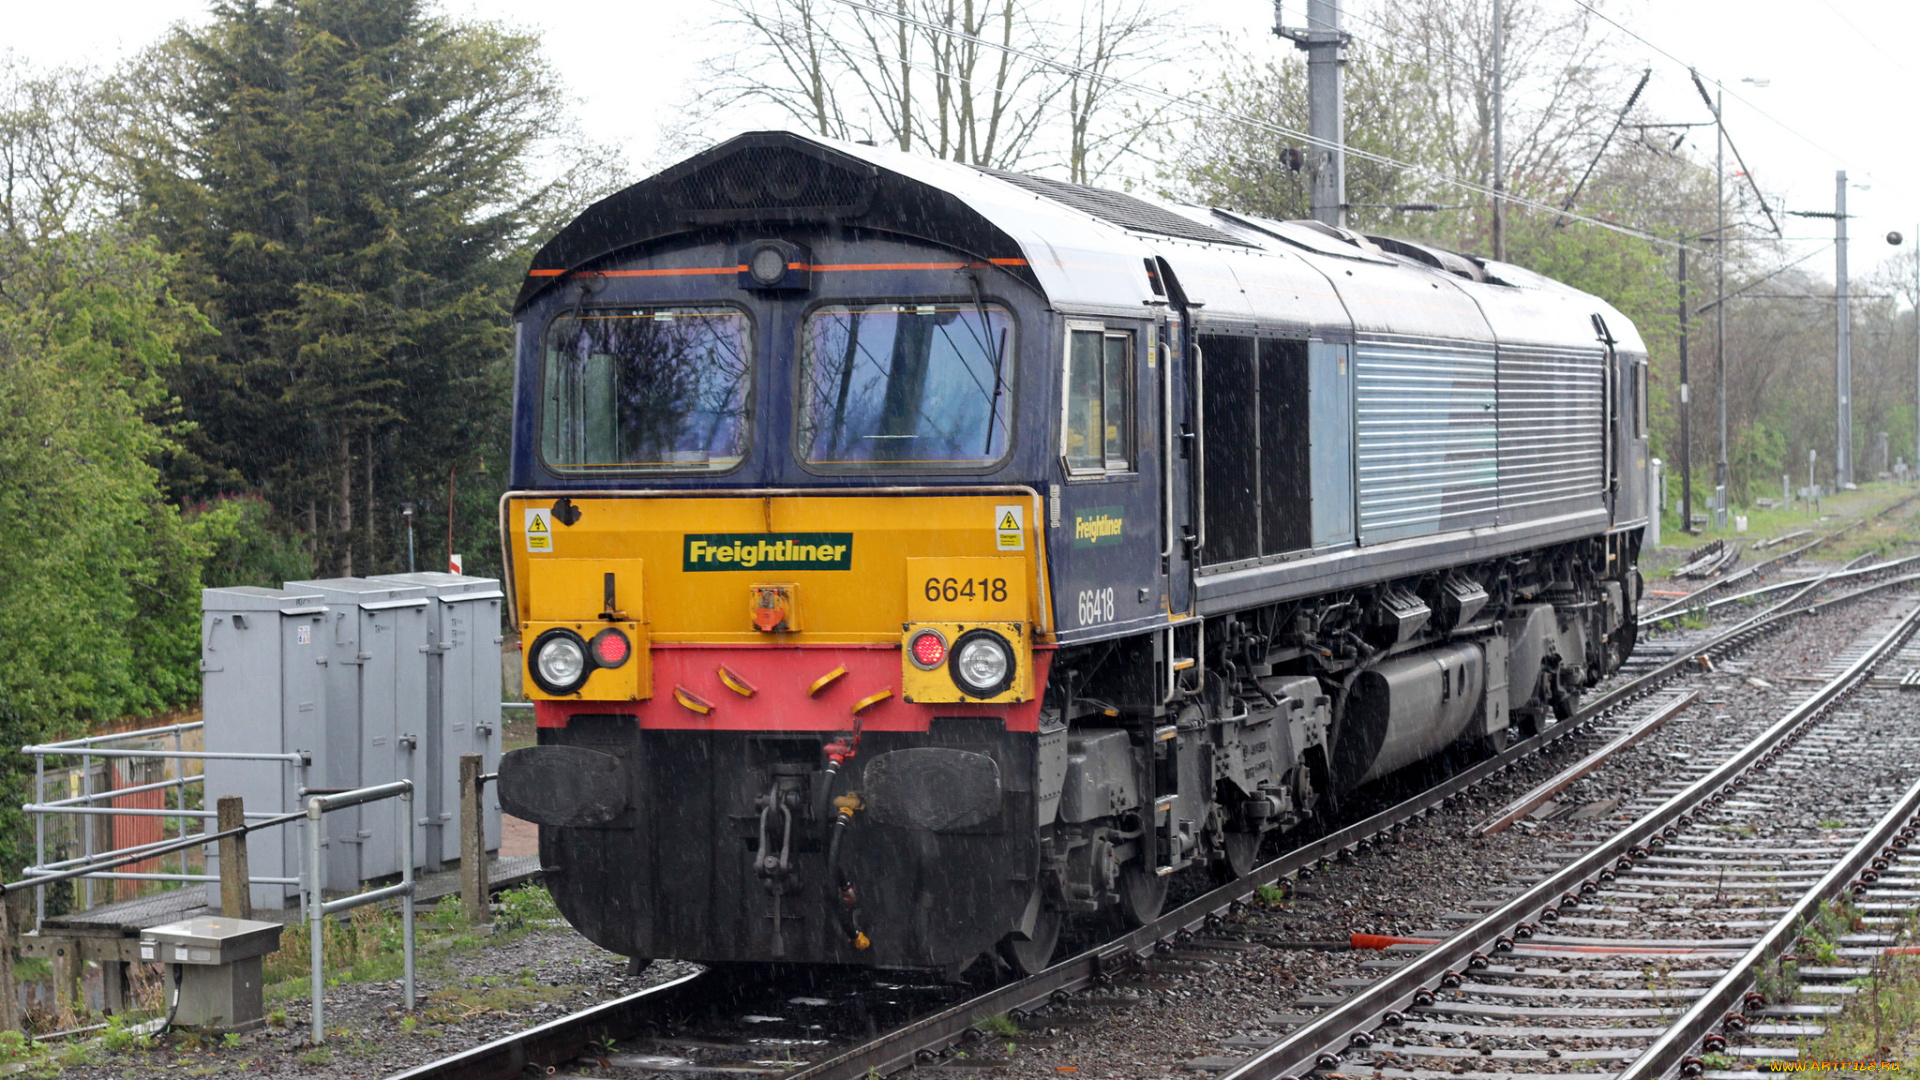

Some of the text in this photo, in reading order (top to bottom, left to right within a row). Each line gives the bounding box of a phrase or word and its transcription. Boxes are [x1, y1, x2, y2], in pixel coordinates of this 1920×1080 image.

[1075, 514, 1123, 543] Freightliner
[690, 540, 847, 567] Freightliner
[924, 577, 1007, 602] 66418
[1078, 587, 1115, 625] 66418
